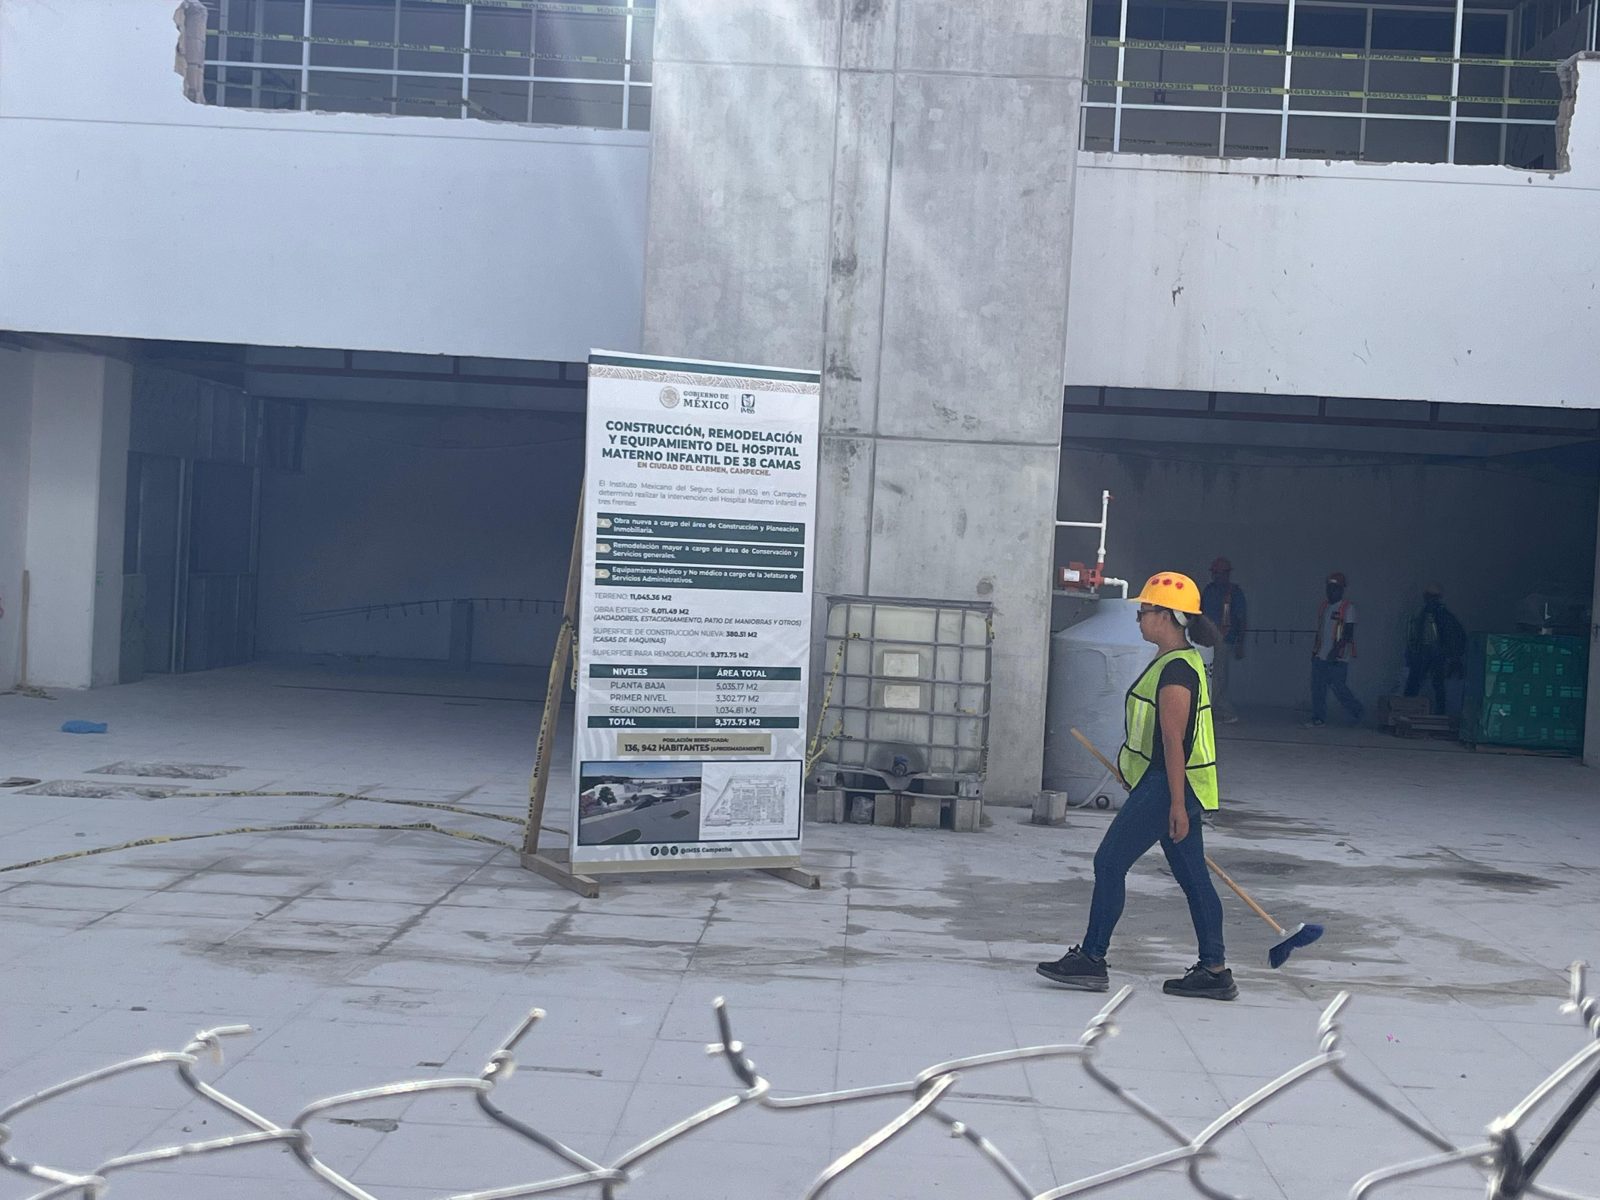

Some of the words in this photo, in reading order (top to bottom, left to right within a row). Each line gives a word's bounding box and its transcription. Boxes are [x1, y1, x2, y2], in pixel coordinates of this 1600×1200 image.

[683, 390, 719, 400] GOBIERNO
[683, 397, 729, 410] MÉXICO
[605, 420, 705, 439] CONSTRUCCIÓN,
[708, 427, 802, 444] REMODELACIÓN
[608, 434, 617, 444] Y
[620, 435, 713, 451] EQUIPAMIENTO
[716, 442, 739, 453] DEL
[741, 444, 799, 457] HOSPITAL
[602, 448, 663, 461] MATERNO
[666, 452, 721, 465] INFANTIL
[723, 456, 740, 466] DE
[742, 457, 757, 468] 38
[759, 458, 801, 470] CAMAS
[649, 462, 678, 470] CIUDAD
[695, 465, 728, 474] CARMEN,
[609, 480, 637, 489] Instituto
[641, 482, 673, 490] Mexicano
[690, 485, 713, 494] Seguro
[716, 486, 735, 494] Social
[738, 487, 758, 496] (IMSS)
[773, 490, 807, 498] Campeche
[634, 491, 658, 499] realizar
[709, 494, 719, 502] del
[720, 495, 747, 504] Hospital
[748, 497, 774, 505] Materno
[775, 499, 797, 507] Infantil
[613, 517, 630, 525] Obra
[659, 520, 678, 528] cargo
[717, 522, 759, 531] Construcción
[765, 525, 799, 533] Planeación
[612, 541, 659, 550] Remodelación
[661, 544, 683, 552] mayor
[691, 545, 710, 553] cargo
[751, 547, 792, 556] Conservación
[612, 550, 642, 558] Servicios
[612, 566, 657, 574] Equipamiento
[658, 567, 682, 575] Médico
[728, 571, 746, 579] cargo
[789, 572, 798, 580] de
[611, 574, 641, 582] Servicios
[642, 575, 694, 584] Administrativos.
[734, 618, 772, 626] MANIOBRAS
[593, 627, 634, 636] SUPERFICIE
[634, 628, 645, 636] DE
[645, 628, 699, 637] CONSTRUCCIÓN
[593, 636, 617, 644] (CASAS
[592, 649, 633, 657] SUPERFICIE
[634, 649, 653, 657] PARA
[612, 668, 648, 676] NIVELES
[716, 667, 739, 677] ÁREA
[741, 669, 767, 678] TOTAL
[610, 681, 643, 689] PLANTA
[716, 682, 745, 691] 5,035.17
[746, 683, 758, 691] M2
[609, 693, 642, 701] PRIMER
[644, 694, 668, 702] NIVEL
[715, 694, 746, 702] 3,302.77
[609, 705, 651, 714] SEGUNDO
[652, 706, 676, 714] NIVEL
[608, 718, 637, 726] TOTAL
[715, 718, 747, 727] 9,373.75
[624, 744, 640, 753] 136,
[641, 744, 657, 752] 942
[658, 744, 710, 752] HABITANTES
